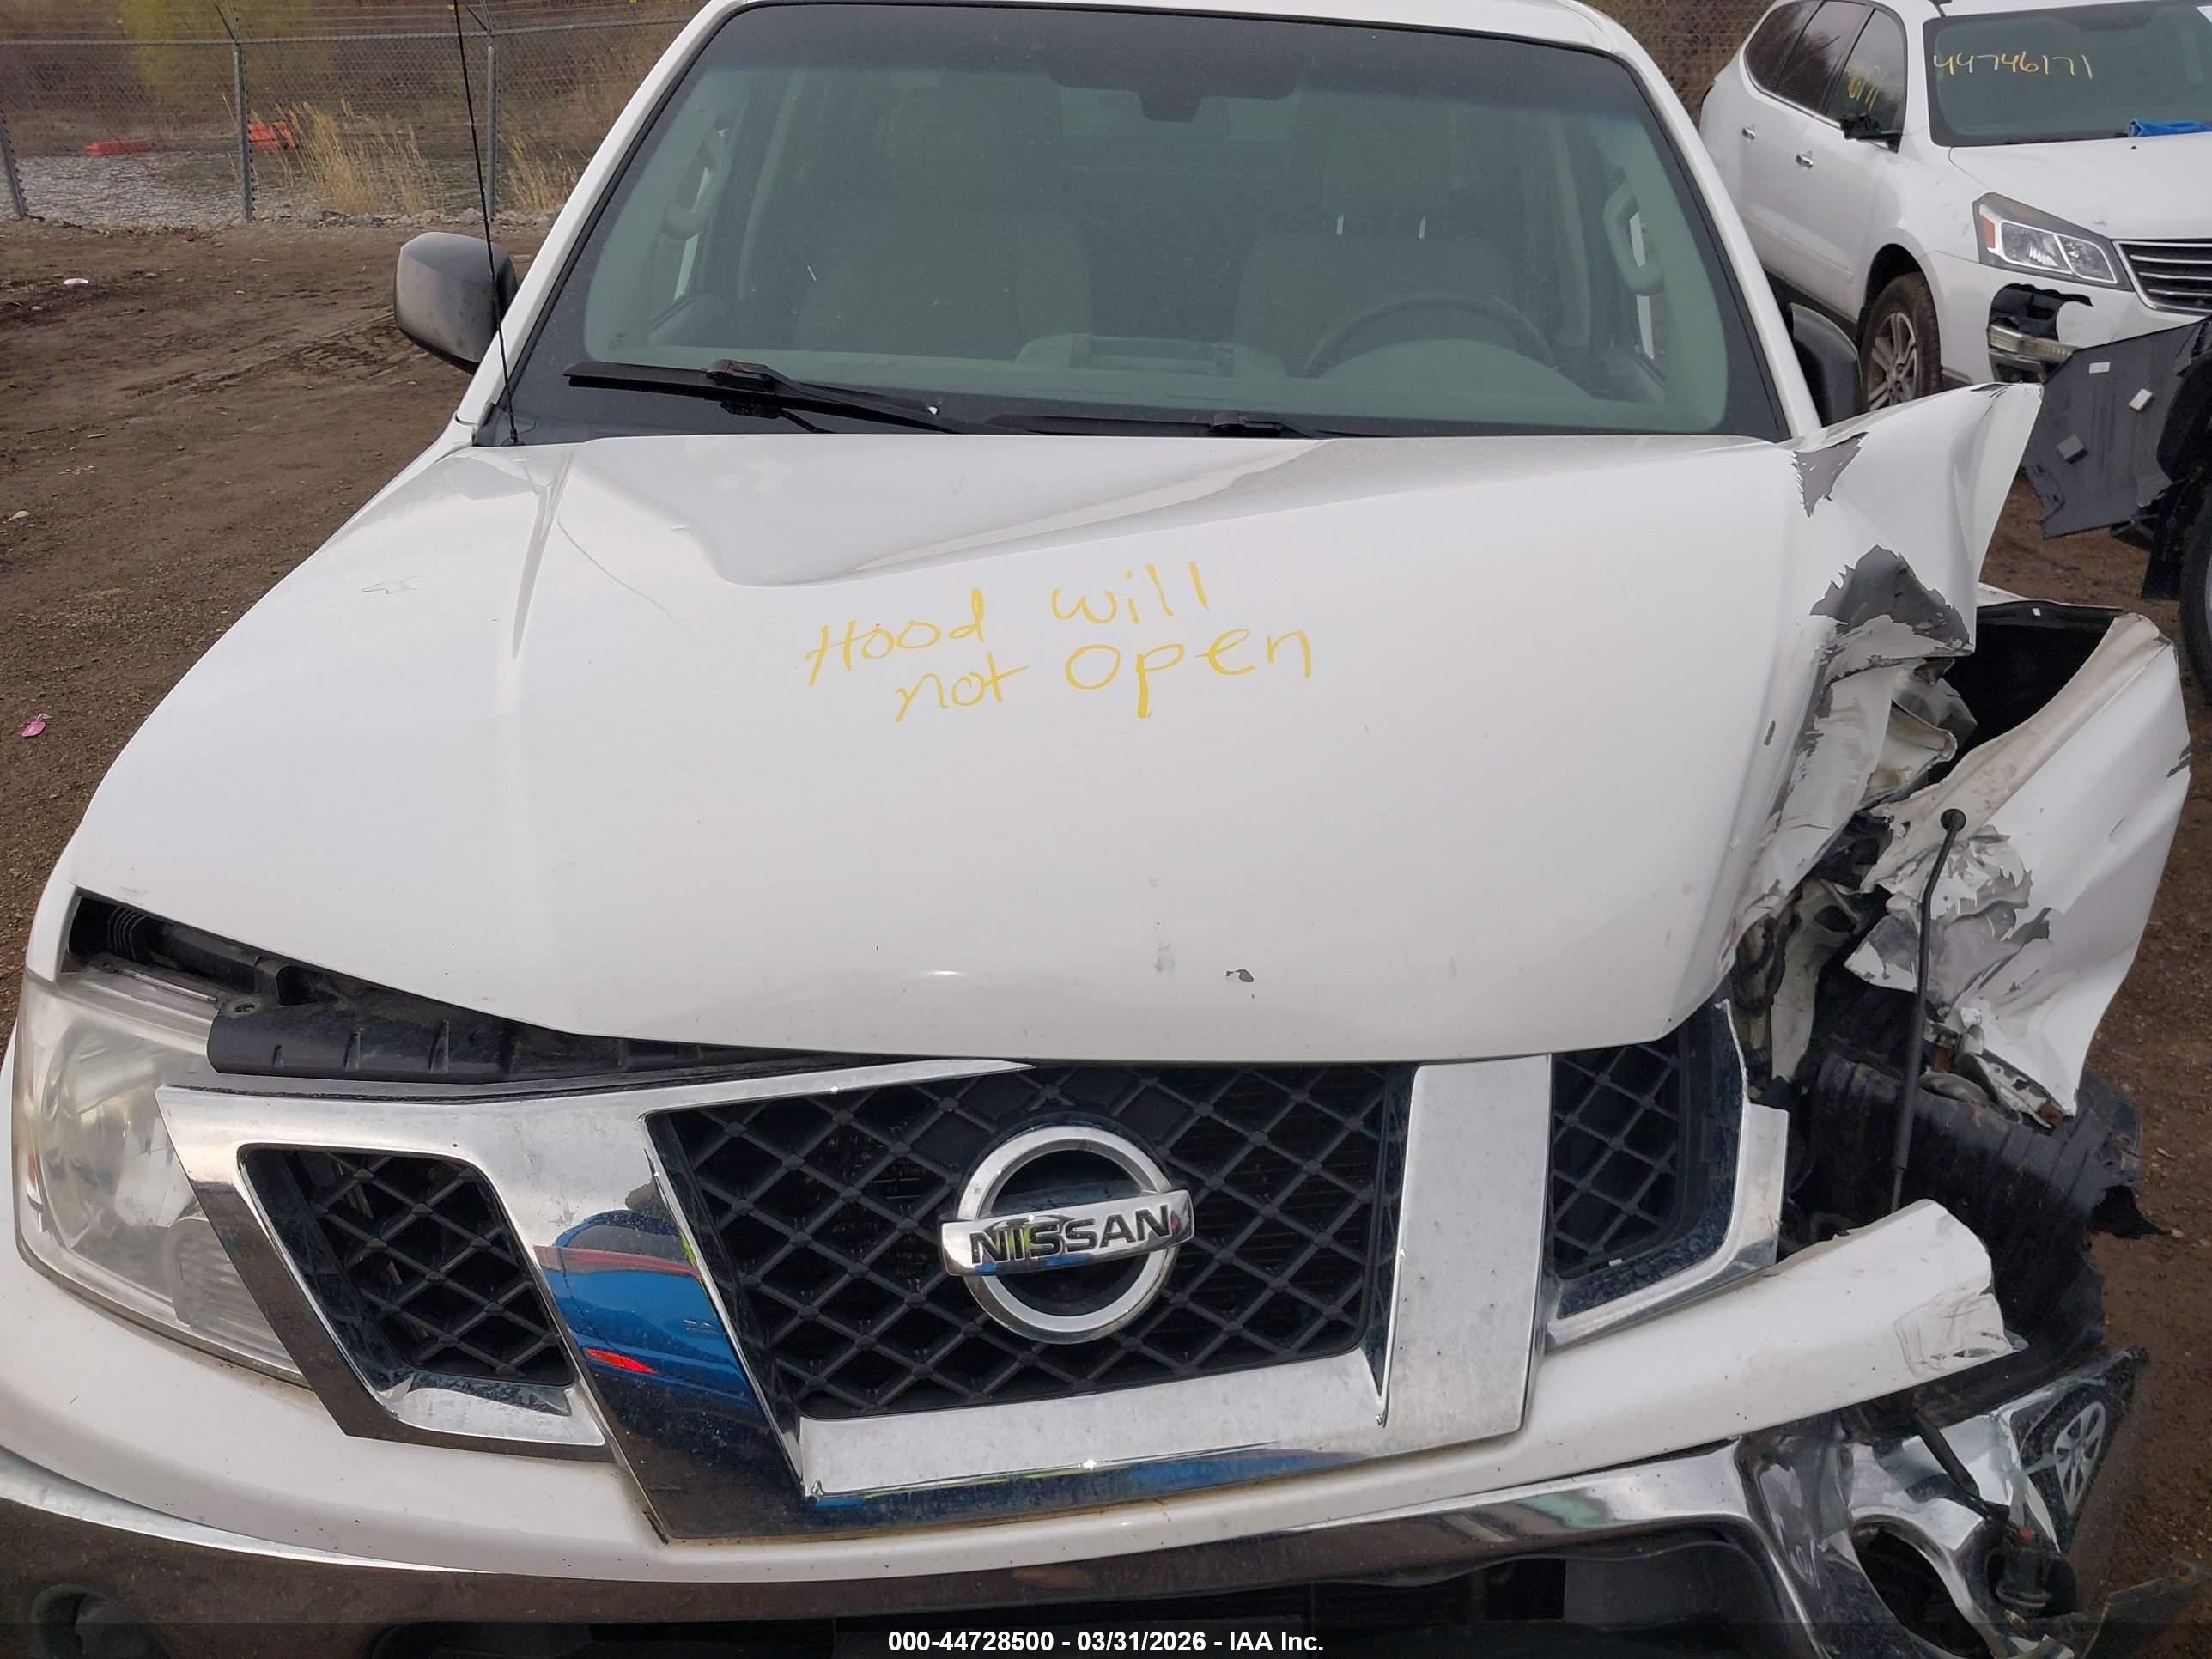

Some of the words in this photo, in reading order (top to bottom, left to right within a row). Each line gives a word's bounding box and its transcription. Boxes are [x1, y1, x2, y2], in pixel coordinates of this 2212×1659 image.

[1933, 51, 2093, 79] 44746171
[804, 588, 987, 686] Hood
[894, 652, 1030, 722] not
[969, 1204, 1171, 1265] NISSAN
